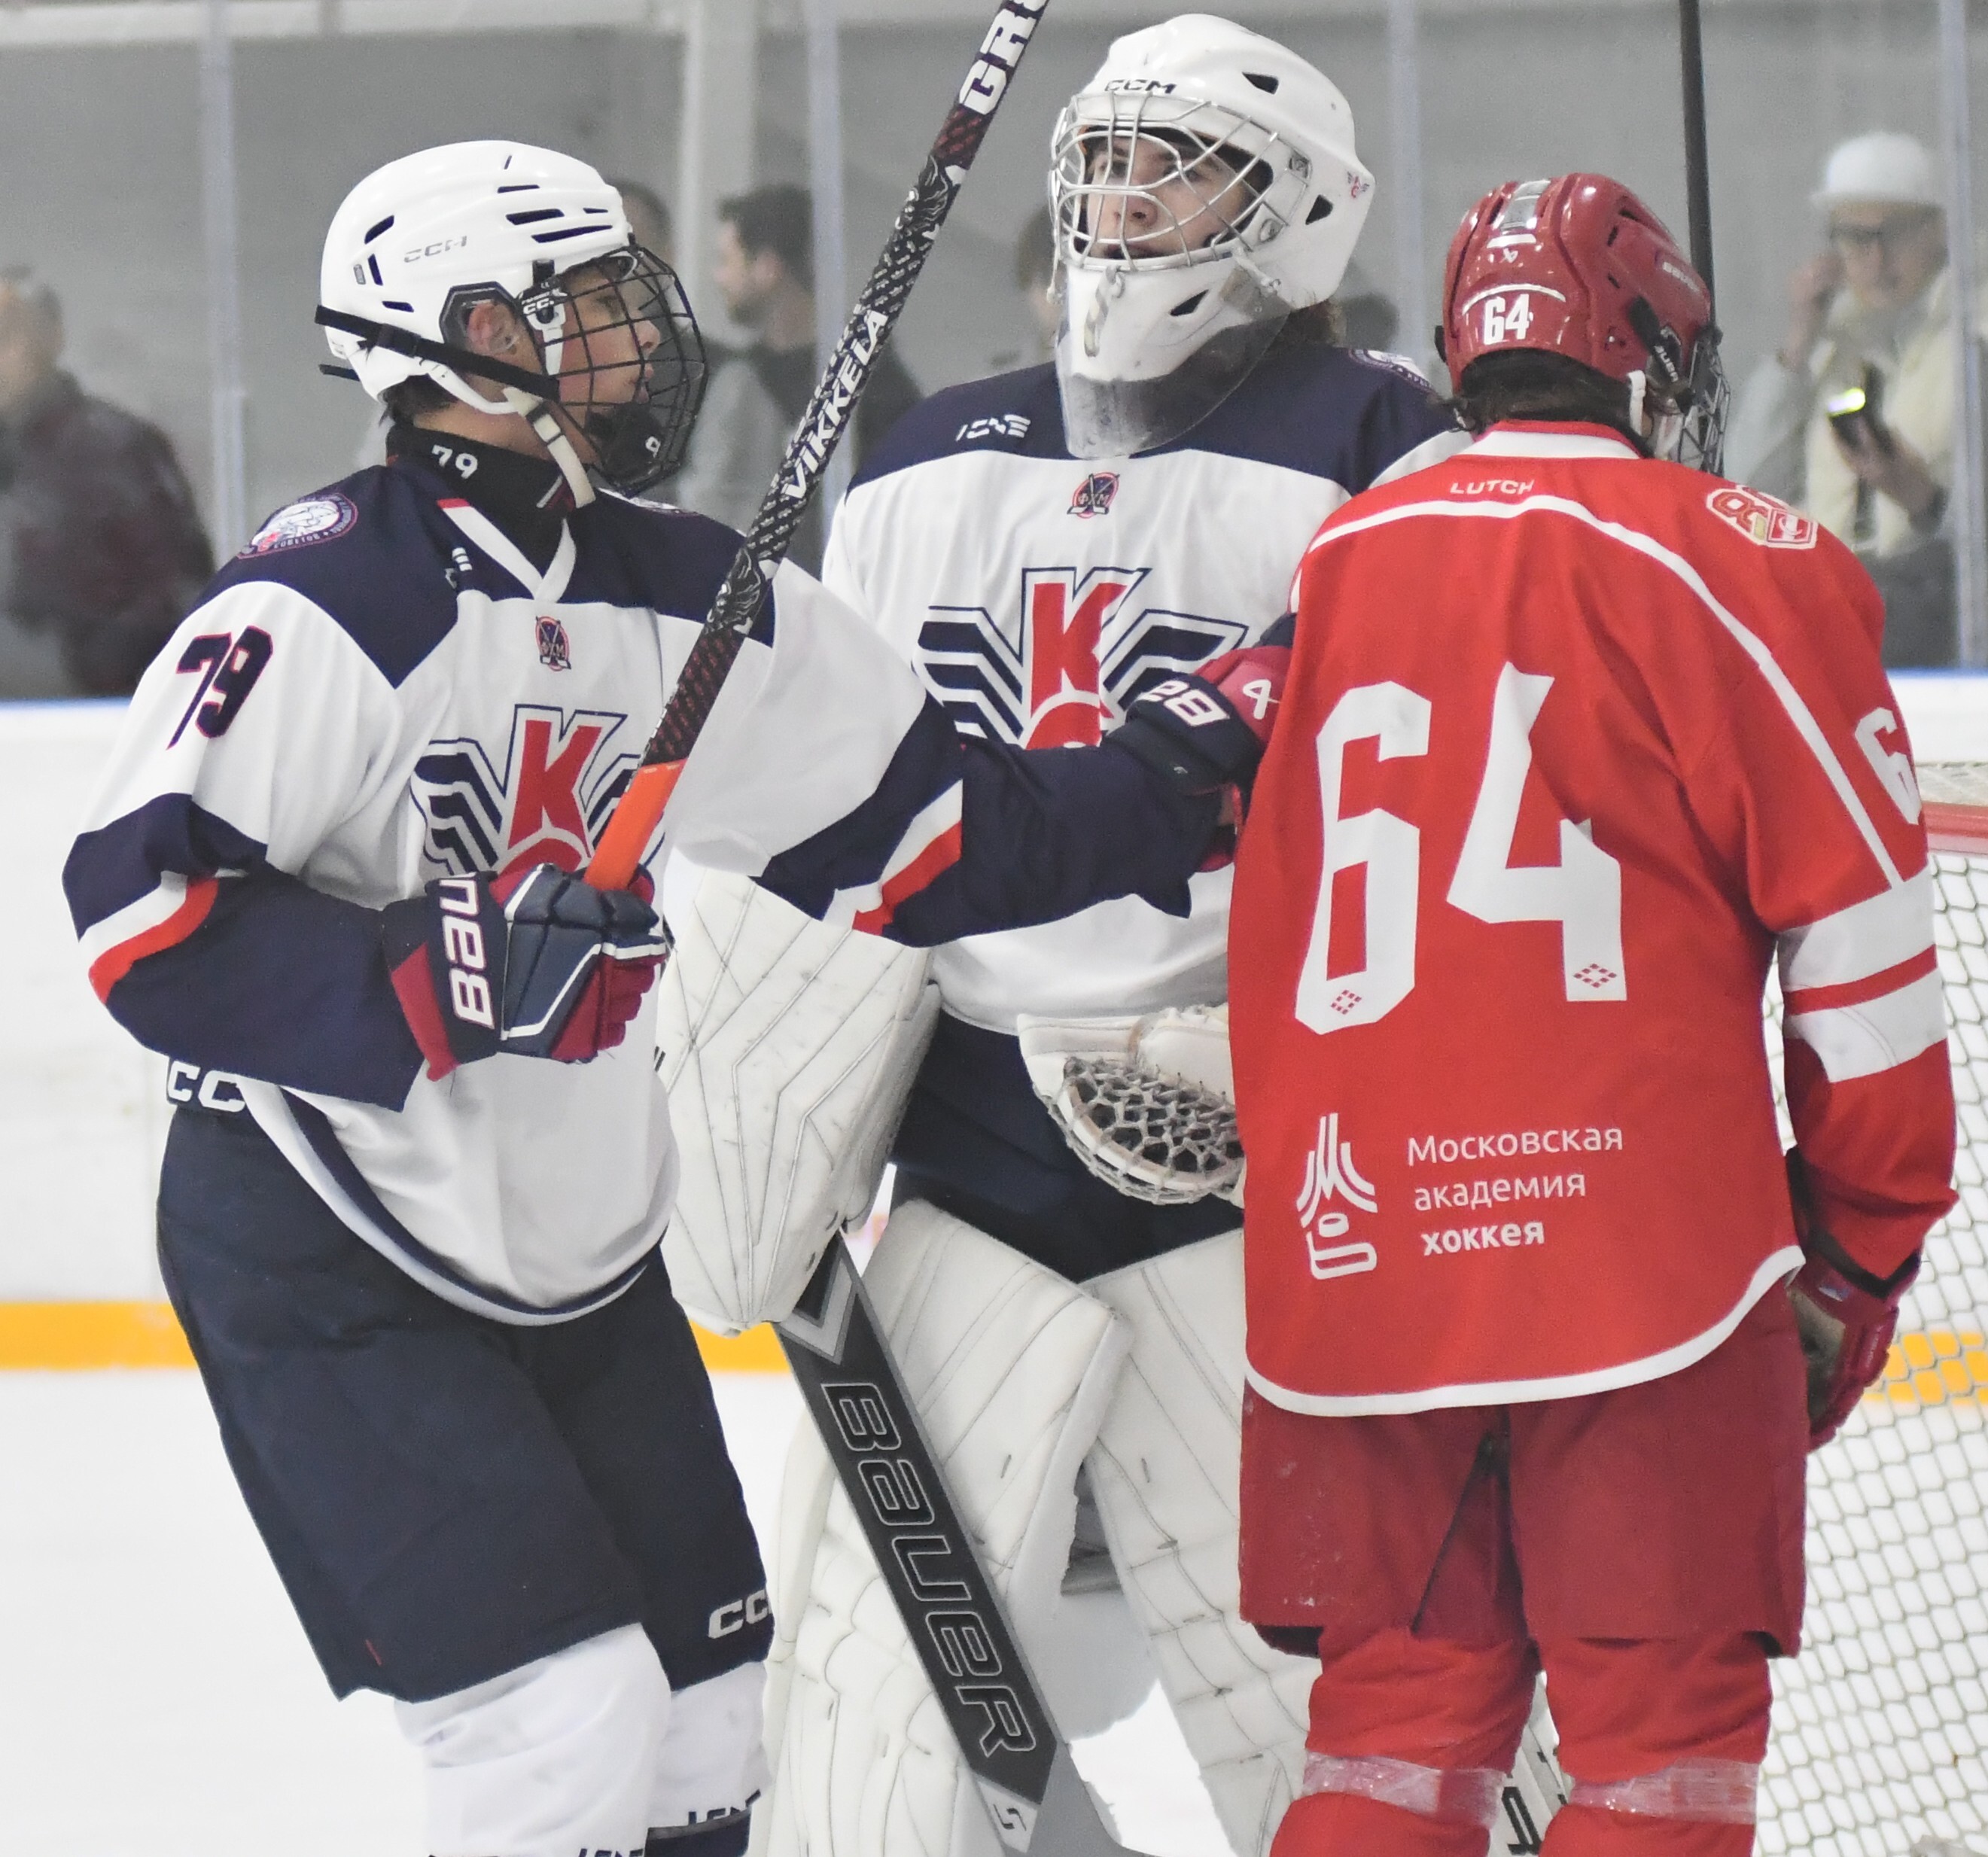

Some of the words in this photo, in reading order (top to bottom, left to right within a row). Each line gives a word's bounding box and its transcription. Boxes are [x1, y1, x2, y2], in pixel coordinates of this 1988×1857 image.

[959, 0, 1046, 115] GR
[1104, 79, 1177, 94] CCM
[404, 236, 467, 263] CCM
[523, 298, 555, 315] CC
[1484, 294, 1530, 346] 64
[781, 309, 888, 499] VIKKELA
[431, 444, 479, 479] 79
[1450, 479, 1534, 495] LUTCH
[167, 626, 273, 750] 79
[1295, 662, 1627, 1035] 64
[439, 872, 495, 1030] BAU
[167, 1060, 246, 1113] CC
[1407, 1127, 1624, 1167] Московская
[1414, 1173, 1587, 1211] академия
[1420, 1221, 1545, 1256] хоккея
[708, 1589, 772, 1639] CC
